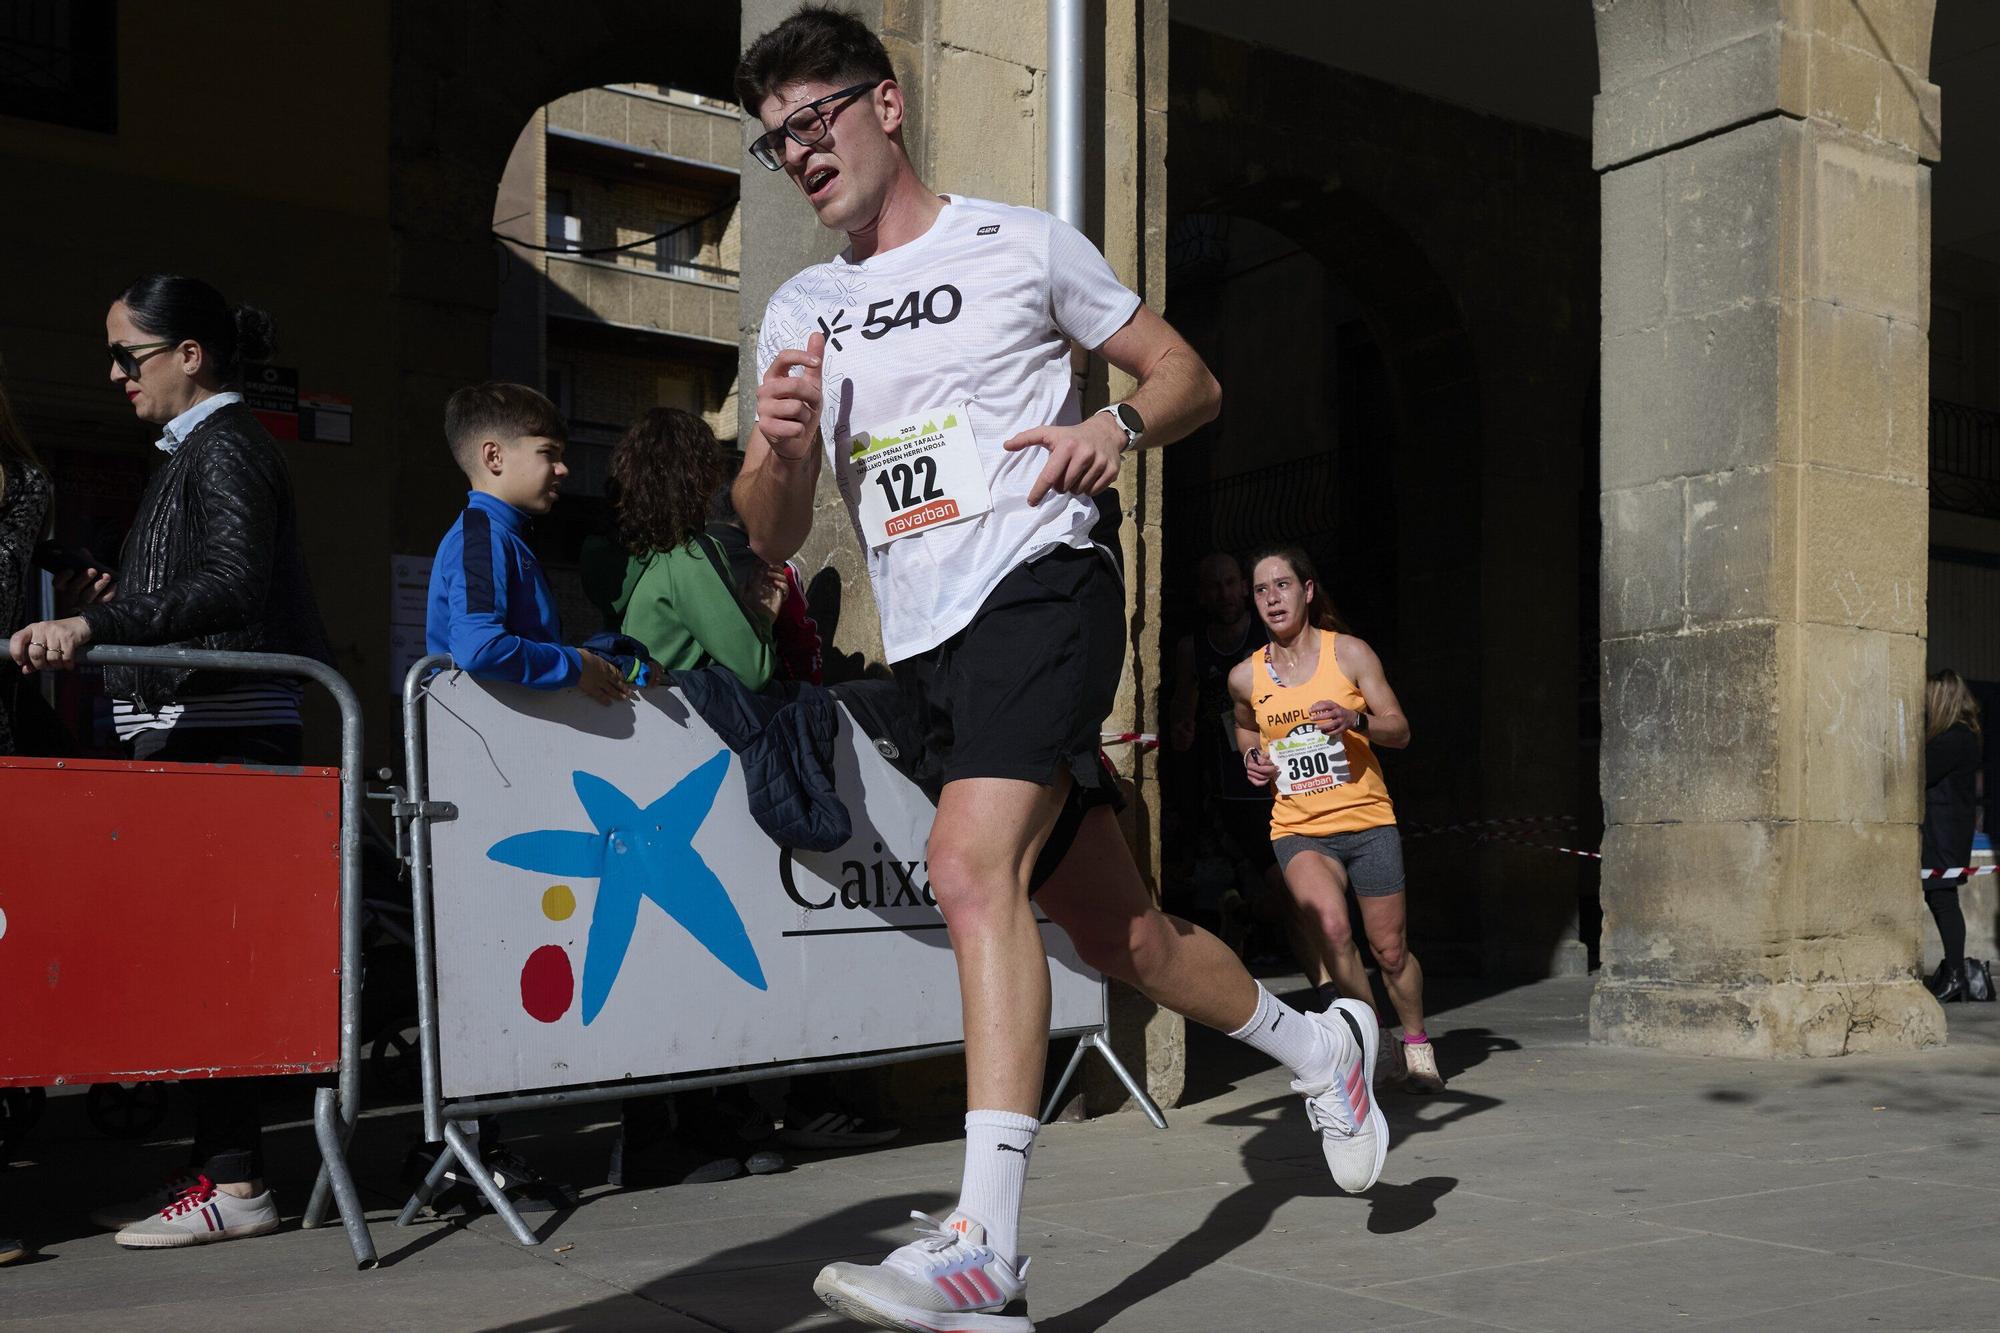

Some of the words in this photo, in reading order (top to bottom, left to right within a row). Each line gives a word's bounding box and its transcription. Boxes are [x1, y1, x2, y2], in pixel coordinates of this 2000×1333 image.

[861, 284, 962, 340] 540
[900, 425, 916, 434] 2025
[867, 453, 882, 463] CROSS
[882, 446, 902, 456] PEÑAS
[903, 442, 912, 450] DE
[914, 433, 944, 446] TAFALLA
[882, 453, 903, 466] PEÑEN
[903, 447, 923, 459] HERRI
[923, 440, 946, 452] KROSA
[875, 455, 945, 513] 122
[888, 502, 957, 533] navarban
[1288, 752, 1329, 780] 390
[1292, 776, 1331, 790] navarban
